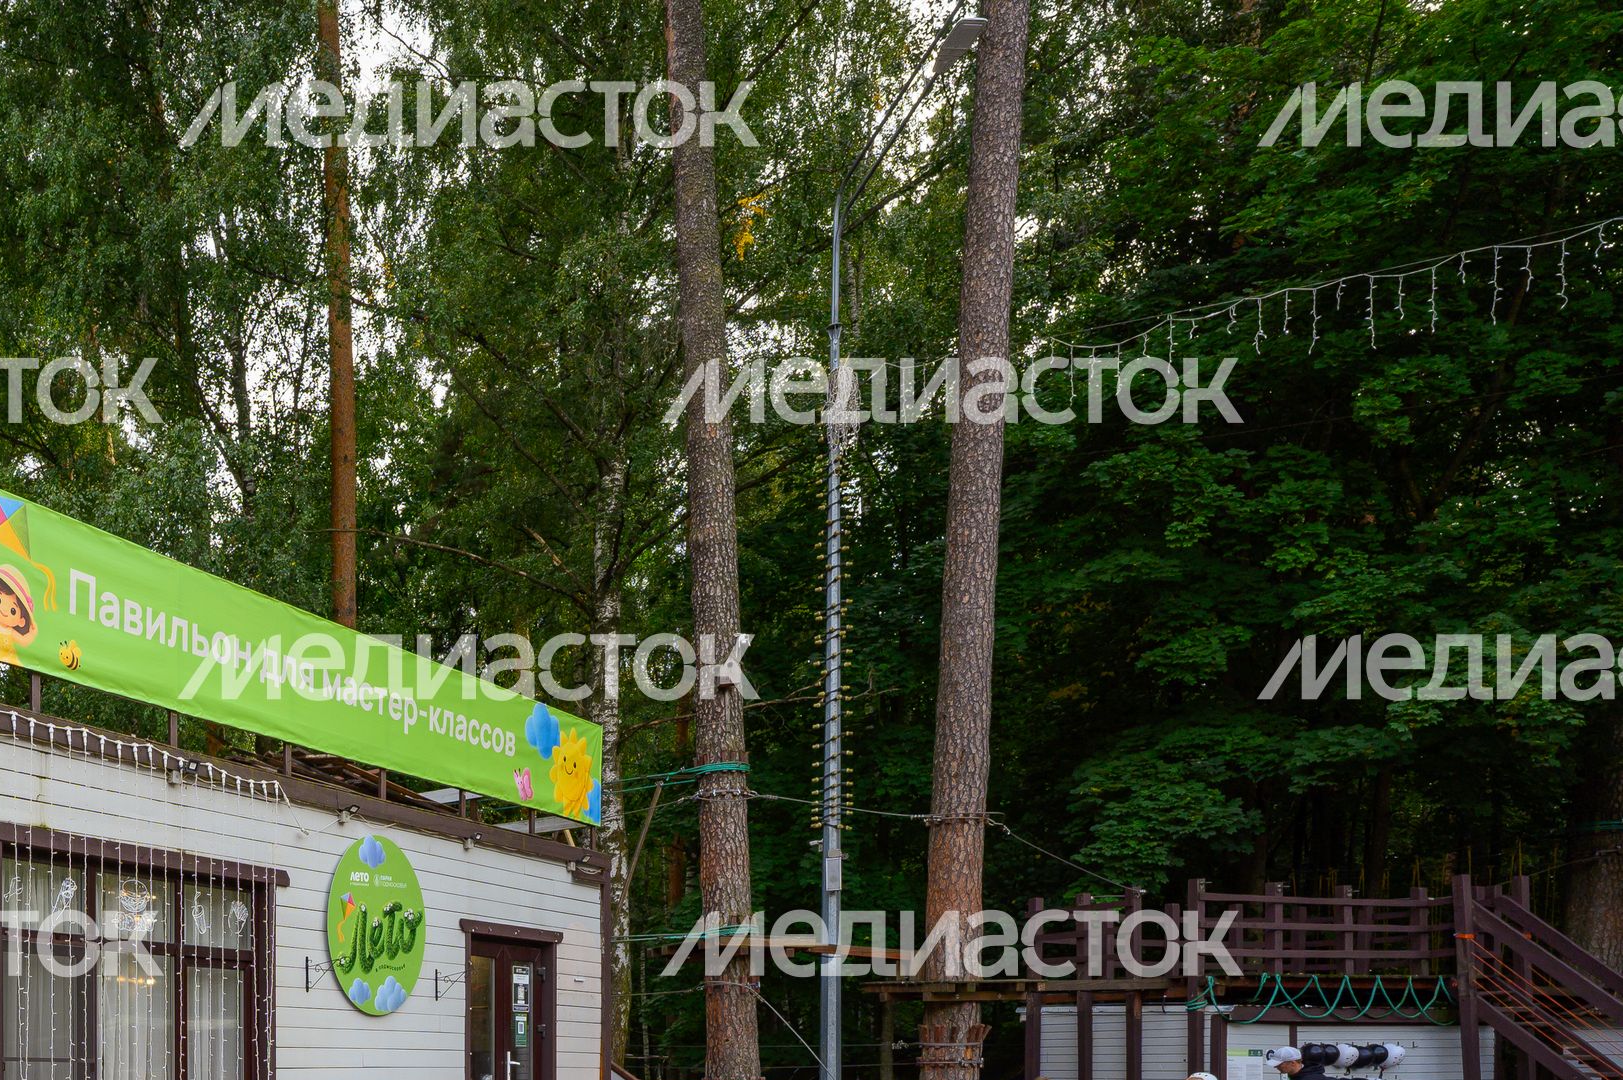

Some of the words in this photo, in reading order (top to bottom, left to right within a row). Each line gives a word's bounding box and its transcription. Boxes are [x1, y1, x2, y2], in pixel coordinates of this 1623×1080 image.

[68, 567, 252, 673] Павильон
[260, 647, 315, 691] для
[322, 667, 517, 757] мастер-классов
